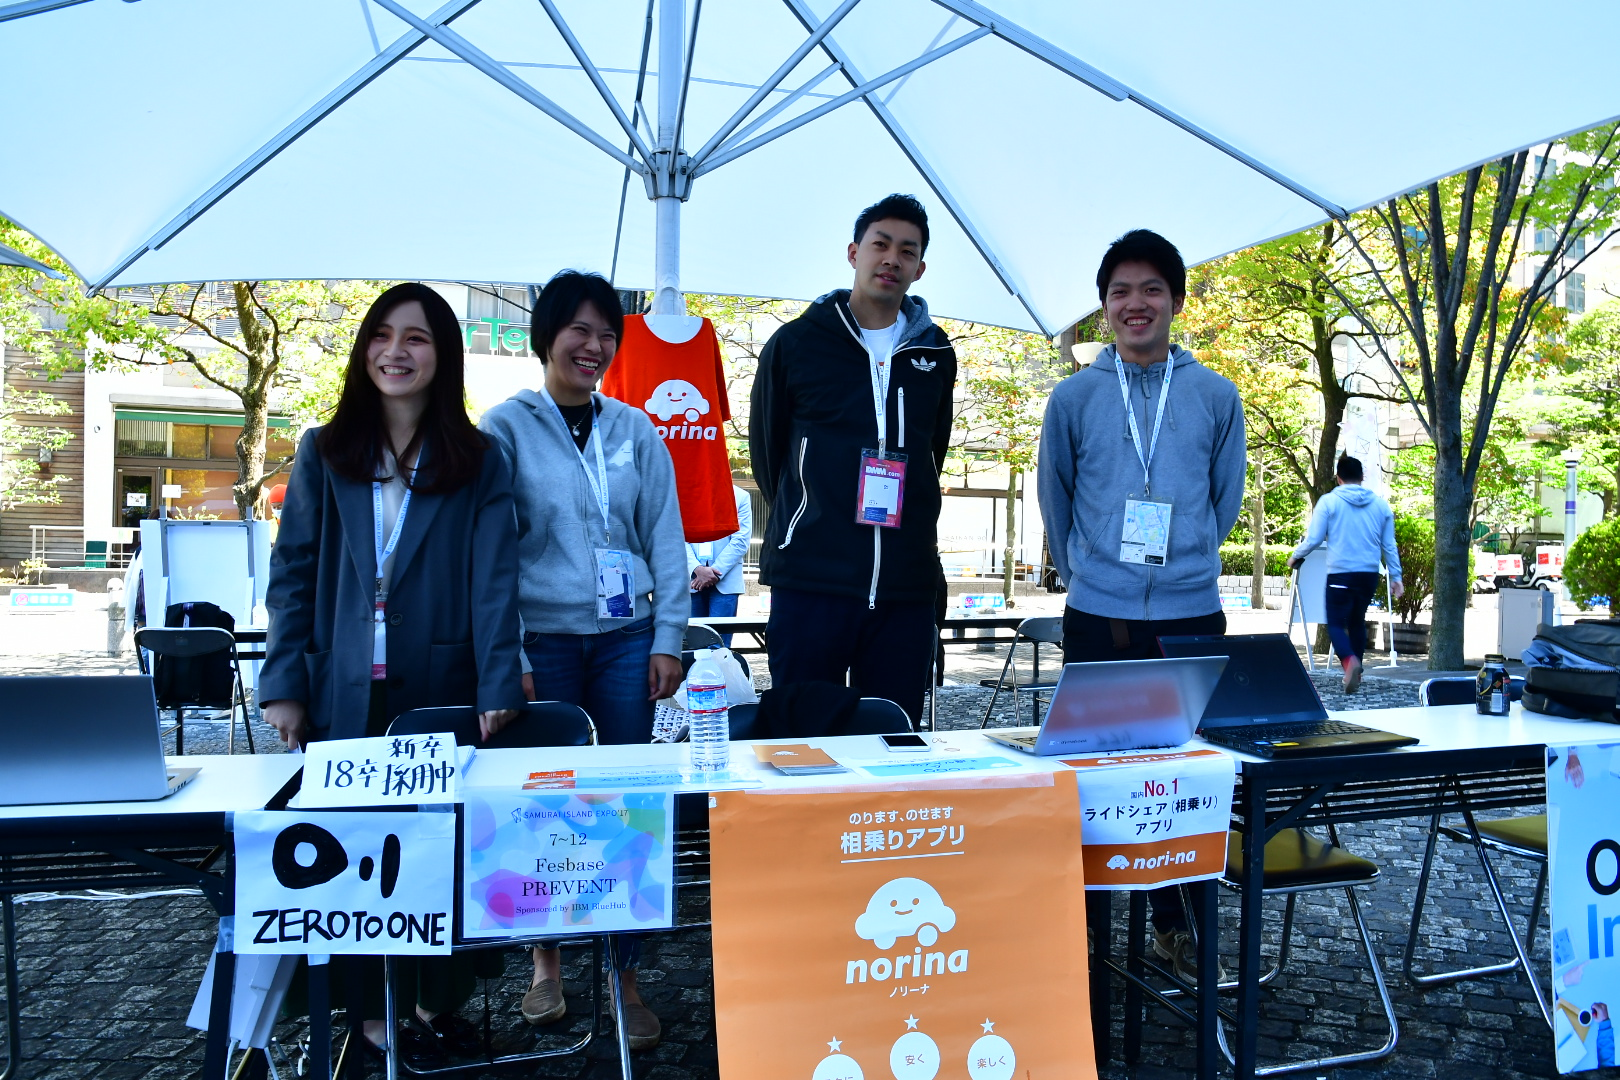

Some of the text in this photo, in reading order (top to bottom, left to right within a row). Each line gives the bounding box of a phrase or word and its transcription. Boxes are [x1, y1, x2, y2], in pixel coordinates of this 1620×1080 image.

[655, 421, 718, 440] orina
[387, 735, 443, 760] 新卒
[524, 809, 629, 819] SAMURAI ISLAND EXPO'17
[1136, 818, 1172, 836] アプリ
[840, 825, 965, 854] 相乗りアプリ
[535, 857, 605, 873] Fesbase
[1133, 850, 1196, 869] nori-na
[522, 878, 617, 897] PREVENT
[515, 901, 627, 915] Sponsored by IBM BlueHub
[845, 946, 969, 984] norina
[889, 983, 930, 998] ノリーナ
[905, 1053, 926, 1066] 安く
[976, 1055, 1007, 1069] 楽しく
